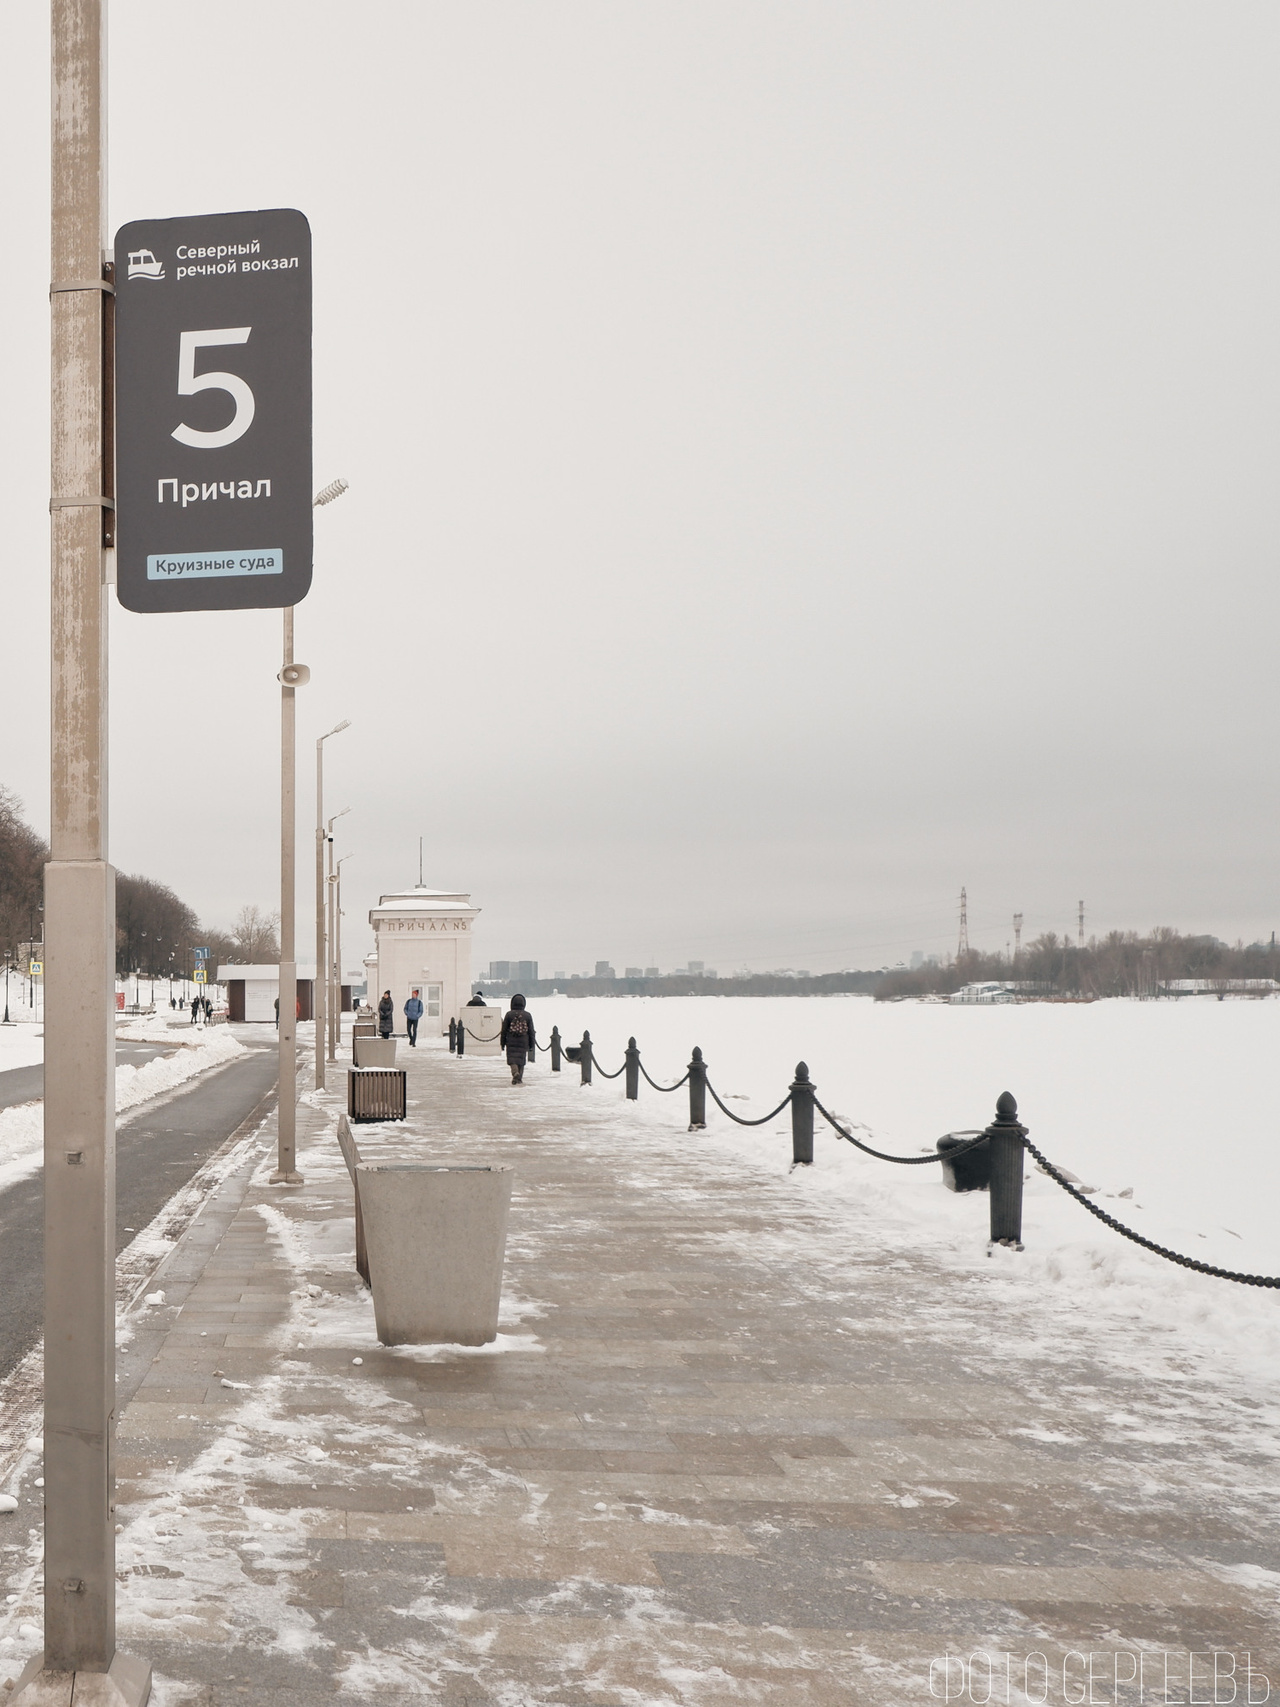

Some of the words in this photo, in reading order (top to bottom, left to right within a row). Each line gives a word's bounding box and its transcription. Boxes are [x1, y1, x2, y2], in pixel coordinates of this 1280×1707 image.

[176, 239, 261, 260] Северный
[176, 259, 237, 280] речной
[241, 257, 299, 272] вокзал
[170, 326, 255, 449] 5
[157, 478, 271, 508] Причал
[156, 559, 235, 575] Круизные
[239, 557, 275, 571] суда
[388, 922, 447, 931] ПРИЧАЛ
